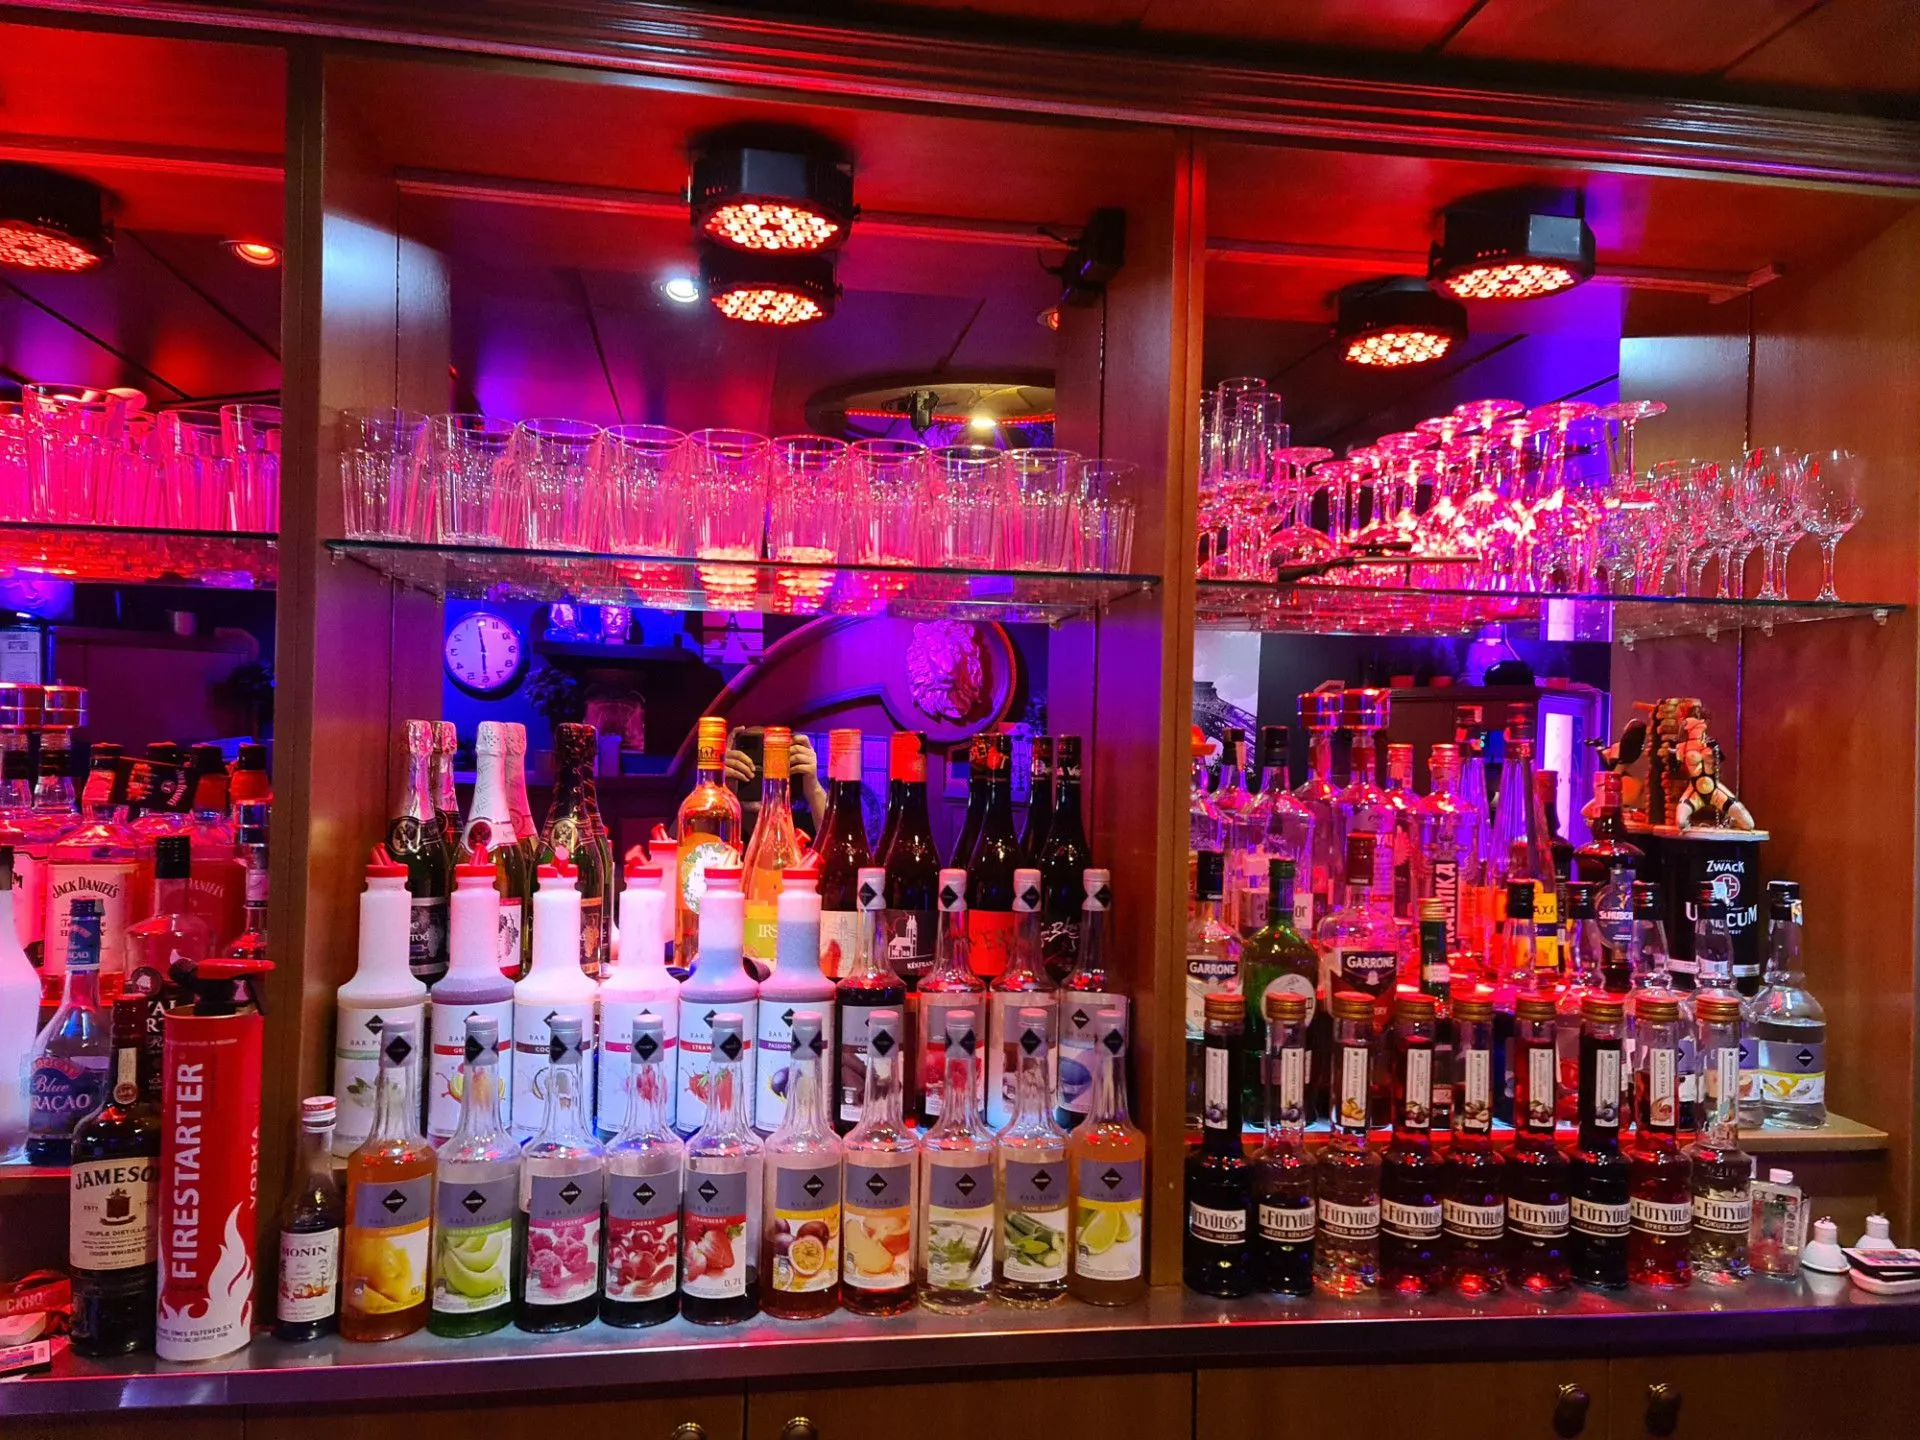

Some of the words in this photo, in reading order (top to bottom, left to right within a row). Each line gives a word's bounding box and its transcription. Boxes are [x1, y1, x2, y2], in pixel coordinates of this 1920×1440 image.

[52, 879, 77, 898] JACK
[1685, 902, 1758, 927] UCUM
[758, 924, 777, 938] IRS
[1189, 961, 1236, 975] GARRONE
[1346, 955, 1395, 968] GARRONE
[35, 1074, 69, 1093] Blue
[30, 1093, 90, 1113] RAÇAO
[171, 1063, 204, 1279] FIRESTARTER
